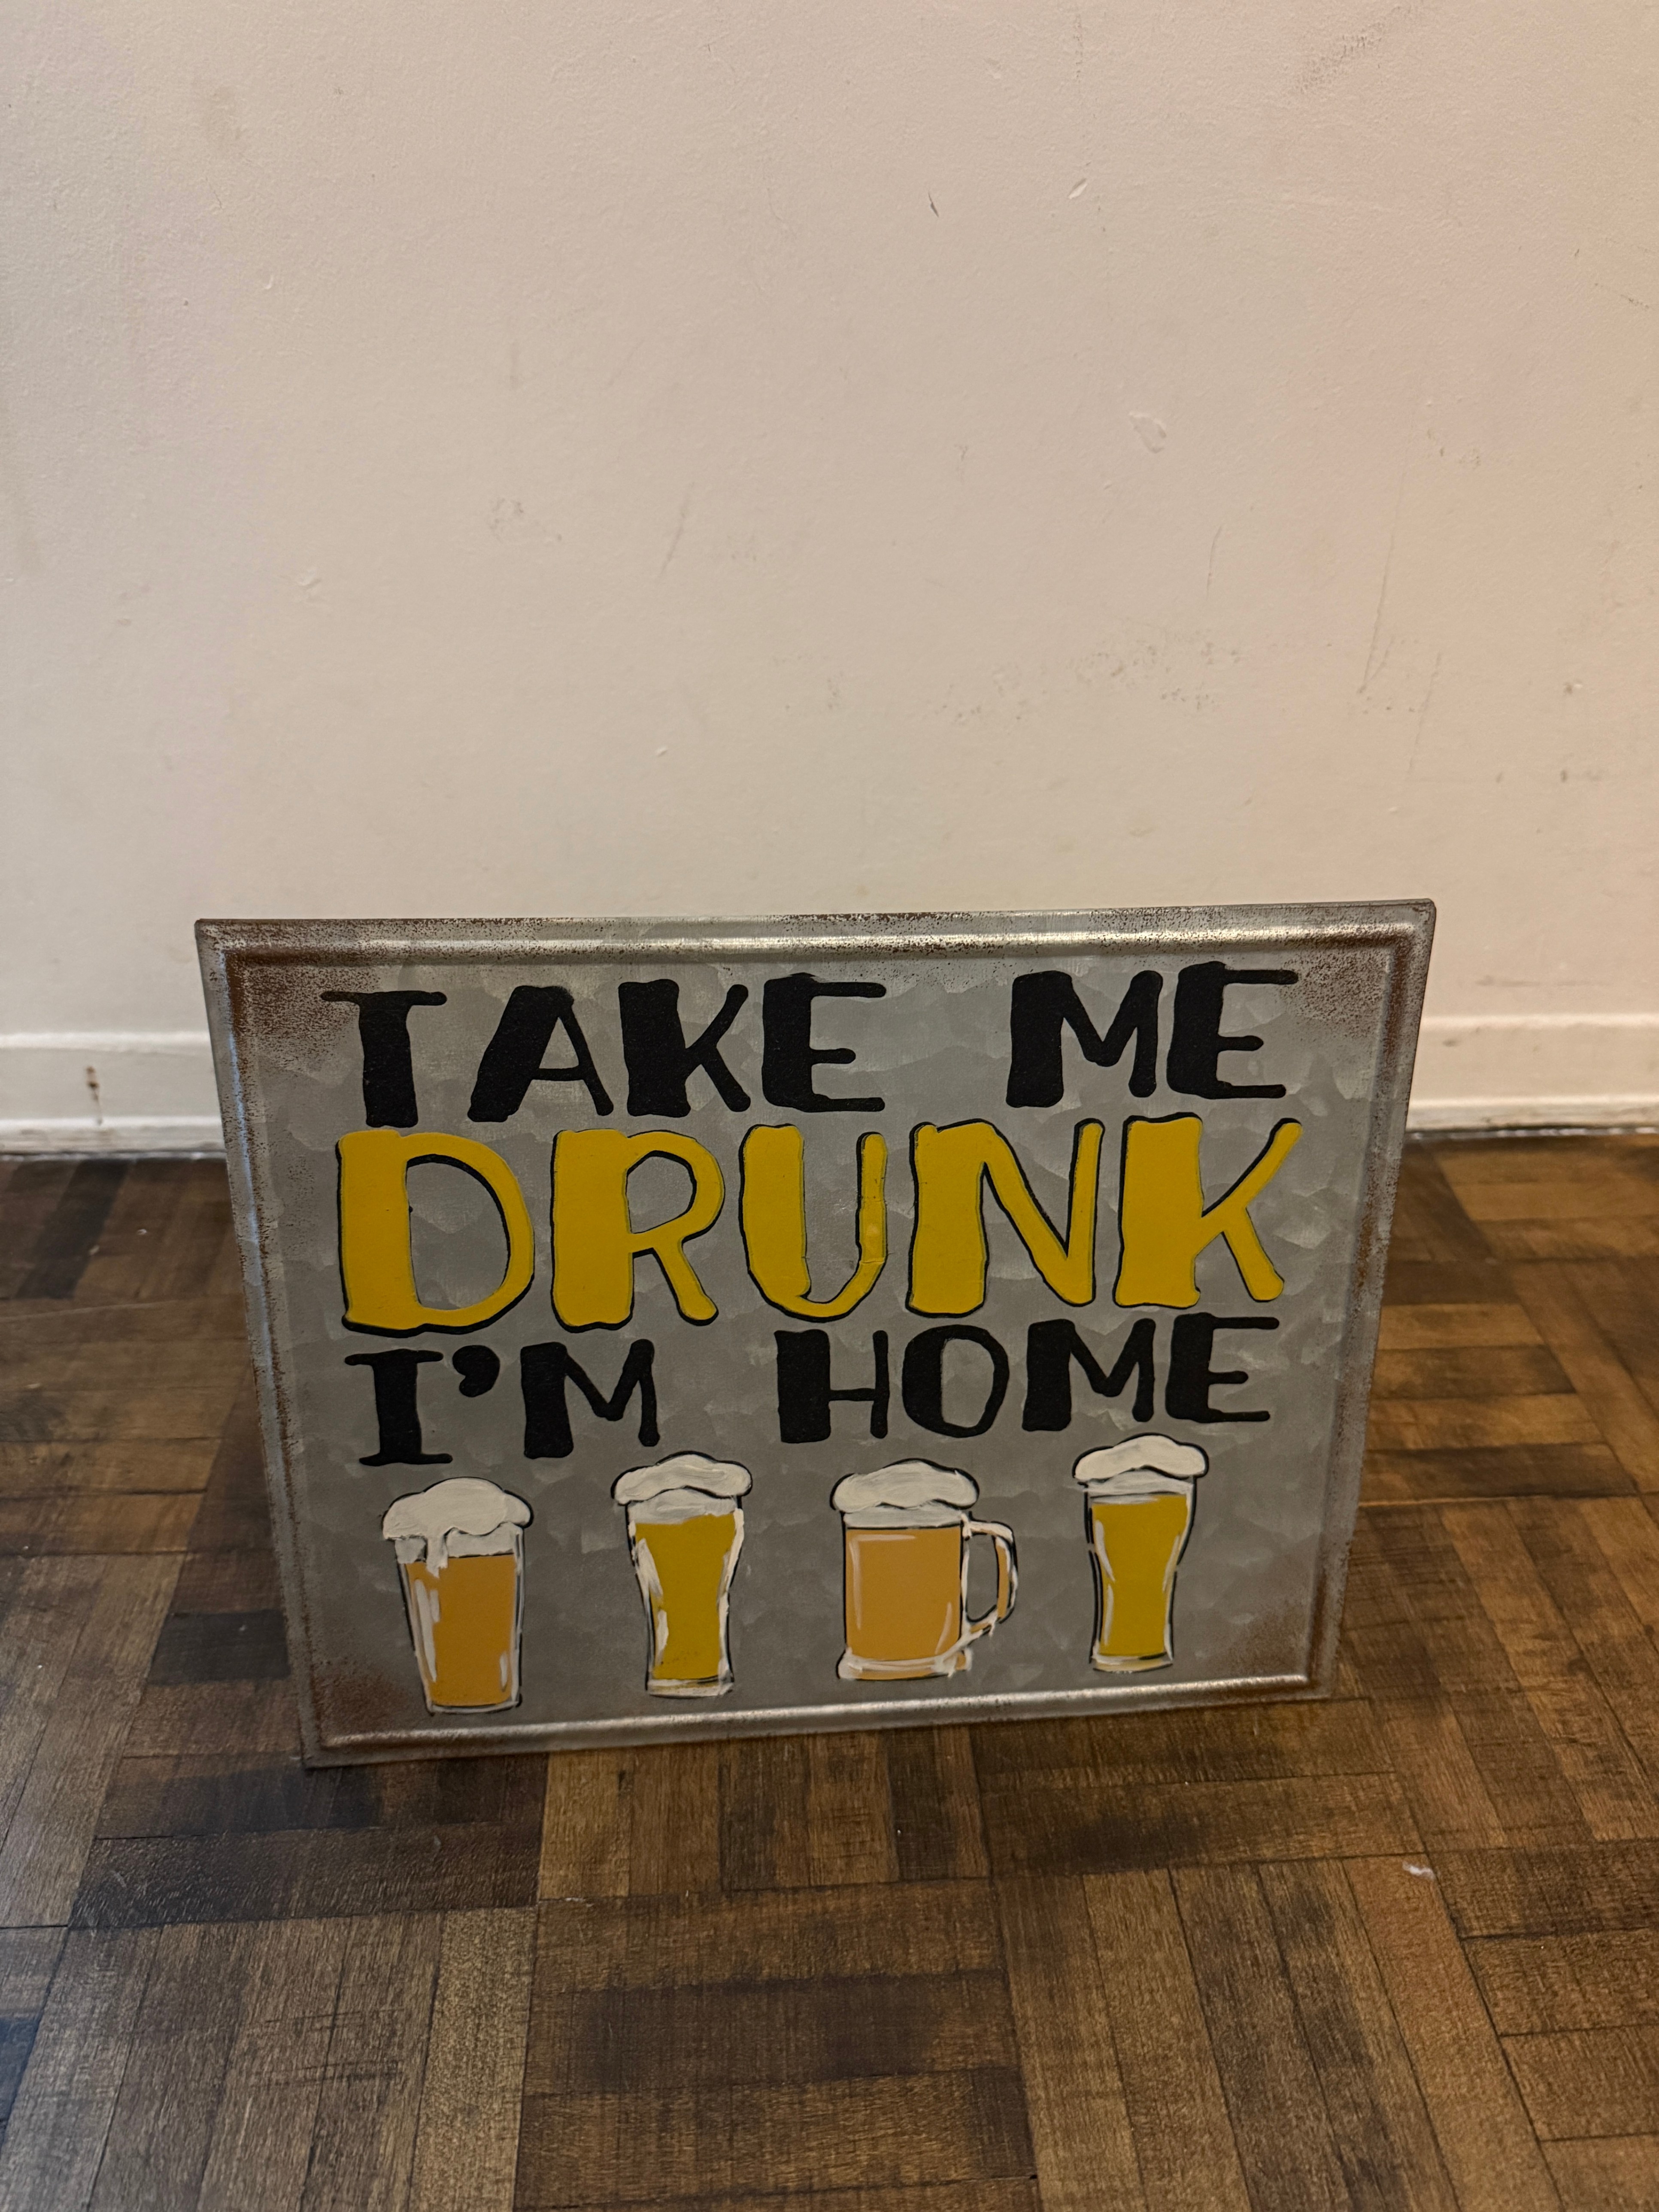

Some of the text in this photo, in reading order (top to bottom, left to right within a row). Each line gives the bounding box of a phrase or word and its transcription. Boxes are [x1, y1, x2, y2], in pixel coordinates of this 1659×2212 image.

[322, 963, 1299, 1126] TAKE ME
[338, 1115, 1301, 1331] DRUNK
[345, 1314, 1279, 1465] I'M HOME
